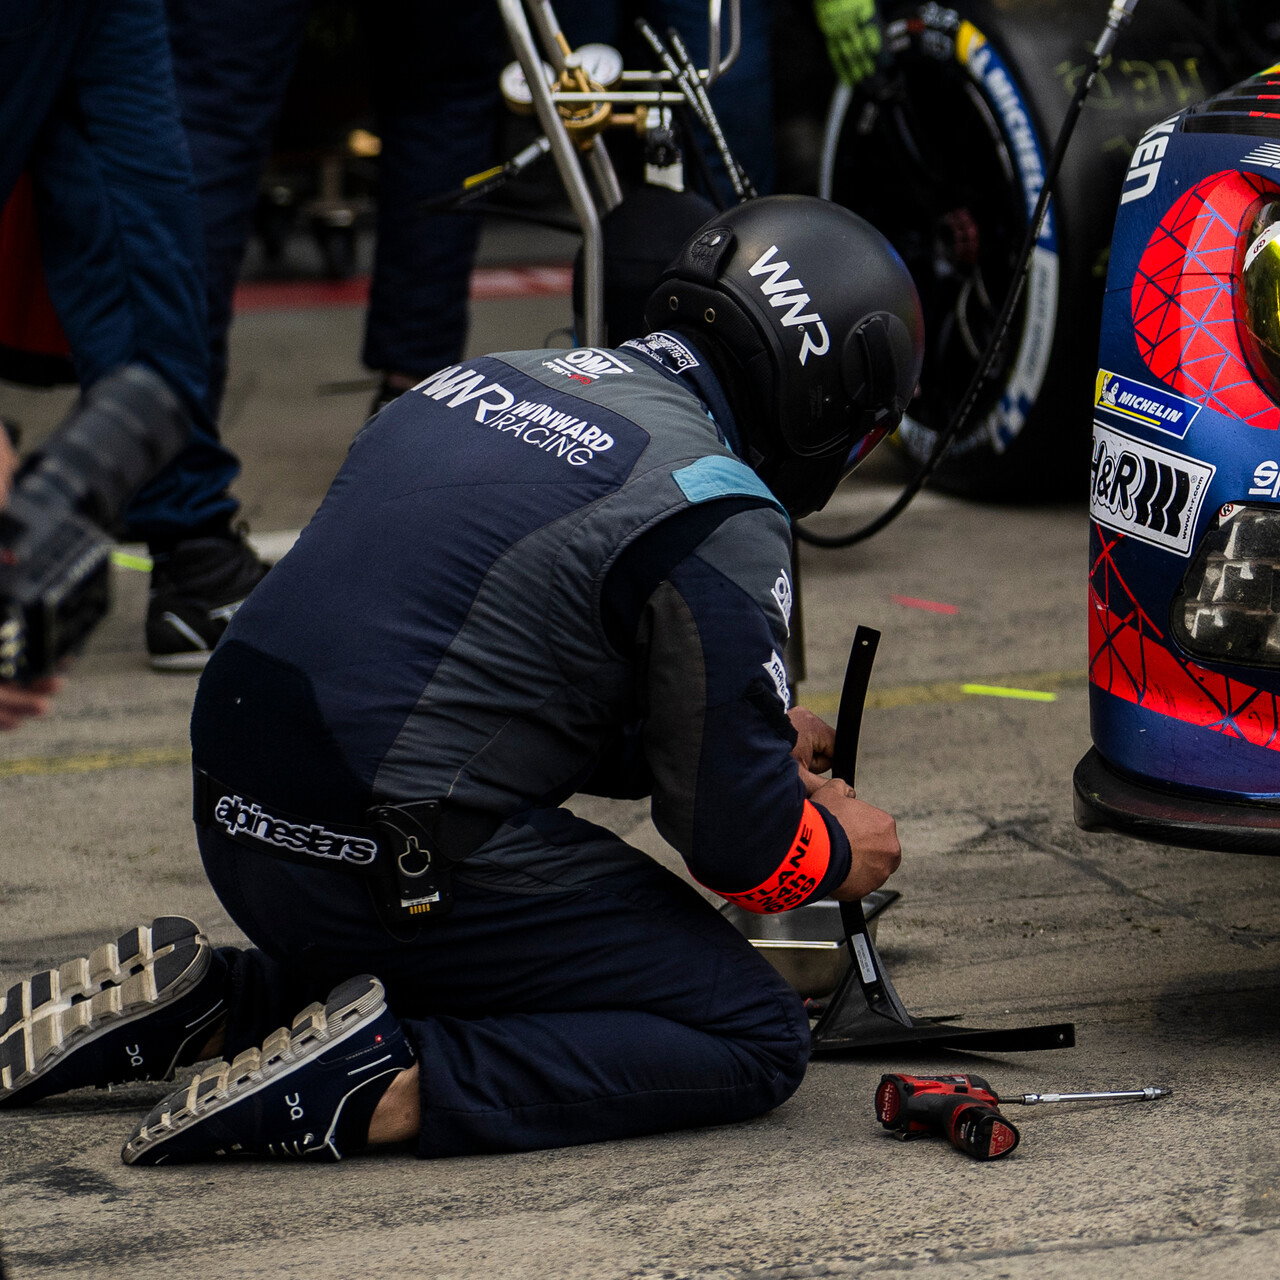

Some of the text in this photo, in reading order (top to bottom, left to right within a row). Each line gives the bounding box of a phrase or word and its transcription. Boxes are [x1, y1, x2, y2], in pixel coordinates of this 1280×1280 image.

[516, 400, 615, 455] WINWARD
[1118, 390, 1184, 423] MICHELIN
[489, 410, 594, 468] RACING
[1181, 475, 1205, 540] www.h-r.com
[214, 795, 378, 866] alpinestars
